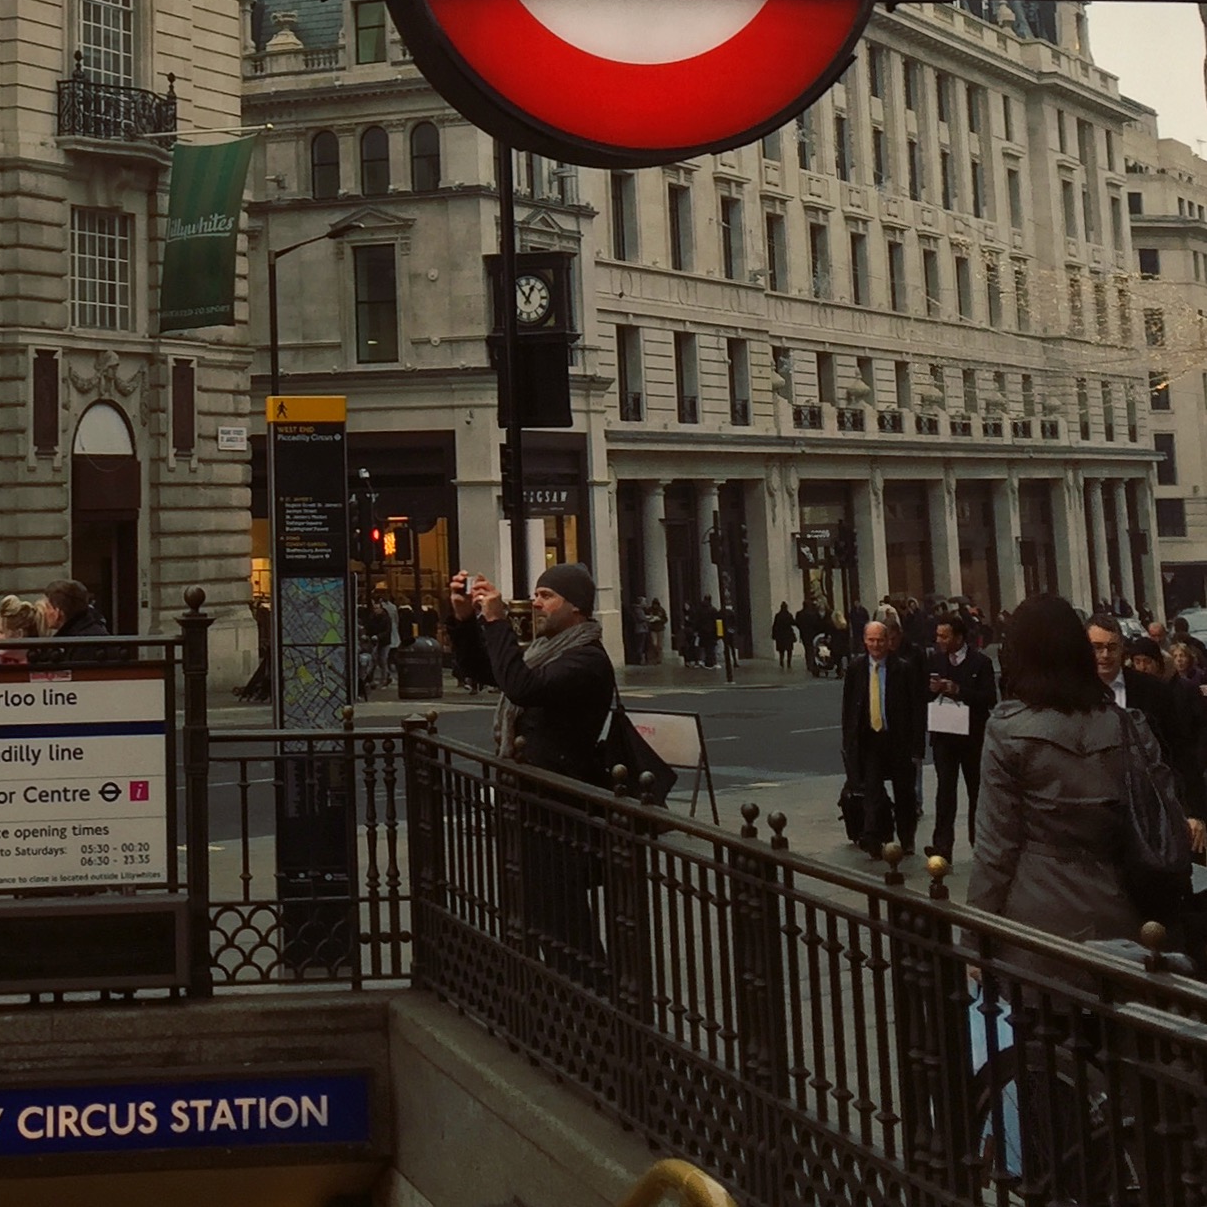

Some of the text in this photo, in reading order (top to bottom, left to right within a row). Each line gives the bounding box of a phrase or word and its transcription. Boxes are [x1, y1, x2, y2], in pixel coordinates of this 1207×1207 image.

[166, 213, 235, 243] Lillywhites
[42, 689, 78, 706] line
[48, 744, 84, 761] line
[23, 785, 91, 803] Centre
[13, 825, 68, 840] opening
[71, 824, 110, 836] times
[0, 848, 12, 857] to
[80, 844, 110, 855] 05:30
[121, 842, 151, 853] 00:20
[80, 856, 110, 867] 06:30
[123, 854, 151, 866] 23:35
[18, 876, 27, 884] to
[29, 875, 50, 883] close
[60, 873, 89, 882] located
[90, 872, 119, 881] outside
[17, 1101, 158, 1140] CIRCUS
[169, 1094, 330, 1134] STATION
